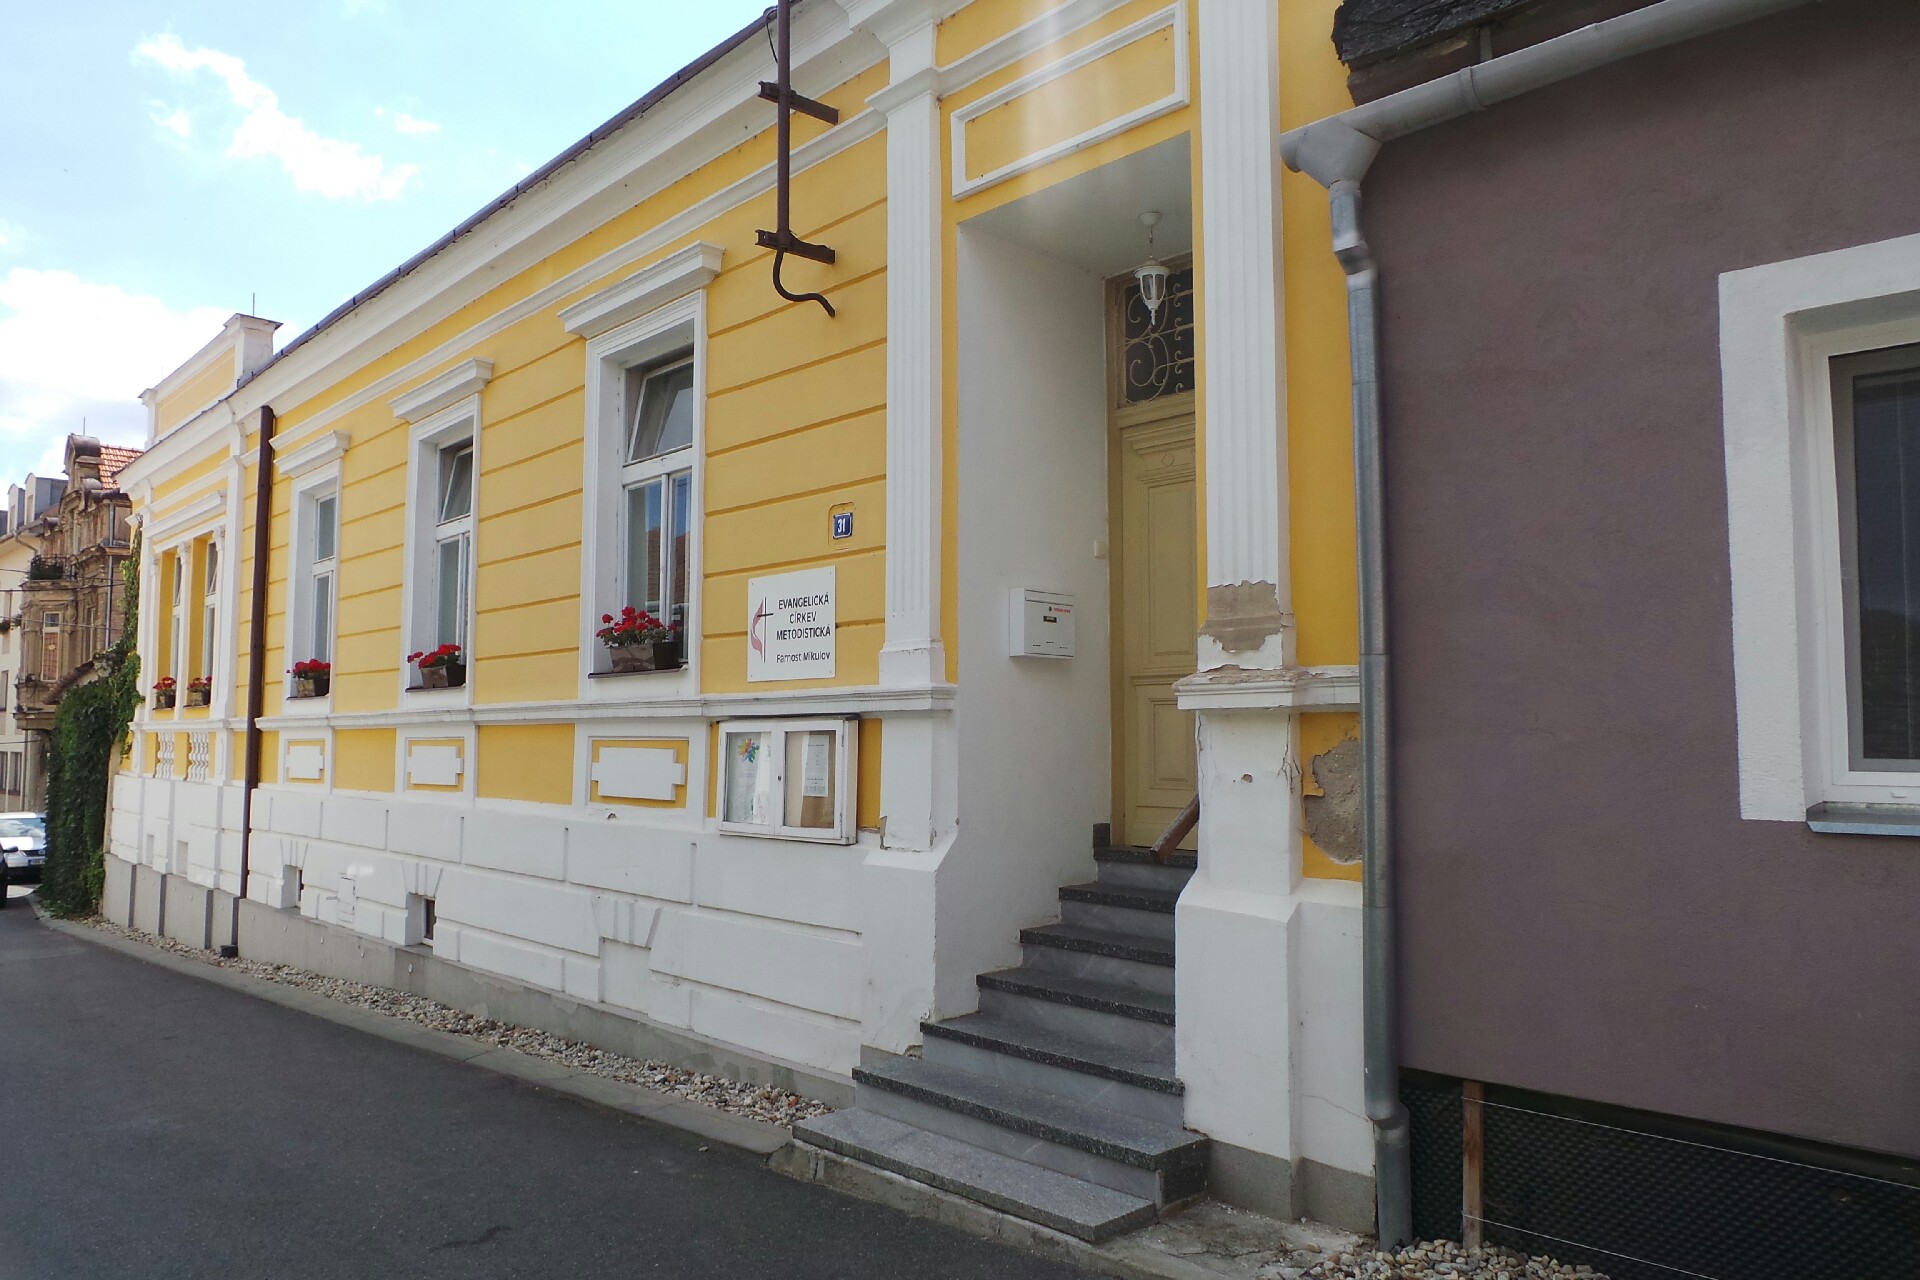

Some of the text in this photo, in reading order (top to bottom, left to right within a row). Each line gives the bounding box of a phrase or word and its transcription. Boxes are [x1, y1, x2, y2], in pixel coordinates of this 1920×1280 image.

[837, 517, 846, 533] 31
[778, 592, 830, 610] EVANGELICKÁ
[789, 611, 817, 624] CÍRKEV
[776, 623, 831, 641] METODISTICKÁ
[776, 650, 831, 663] Farnost Mikulov
